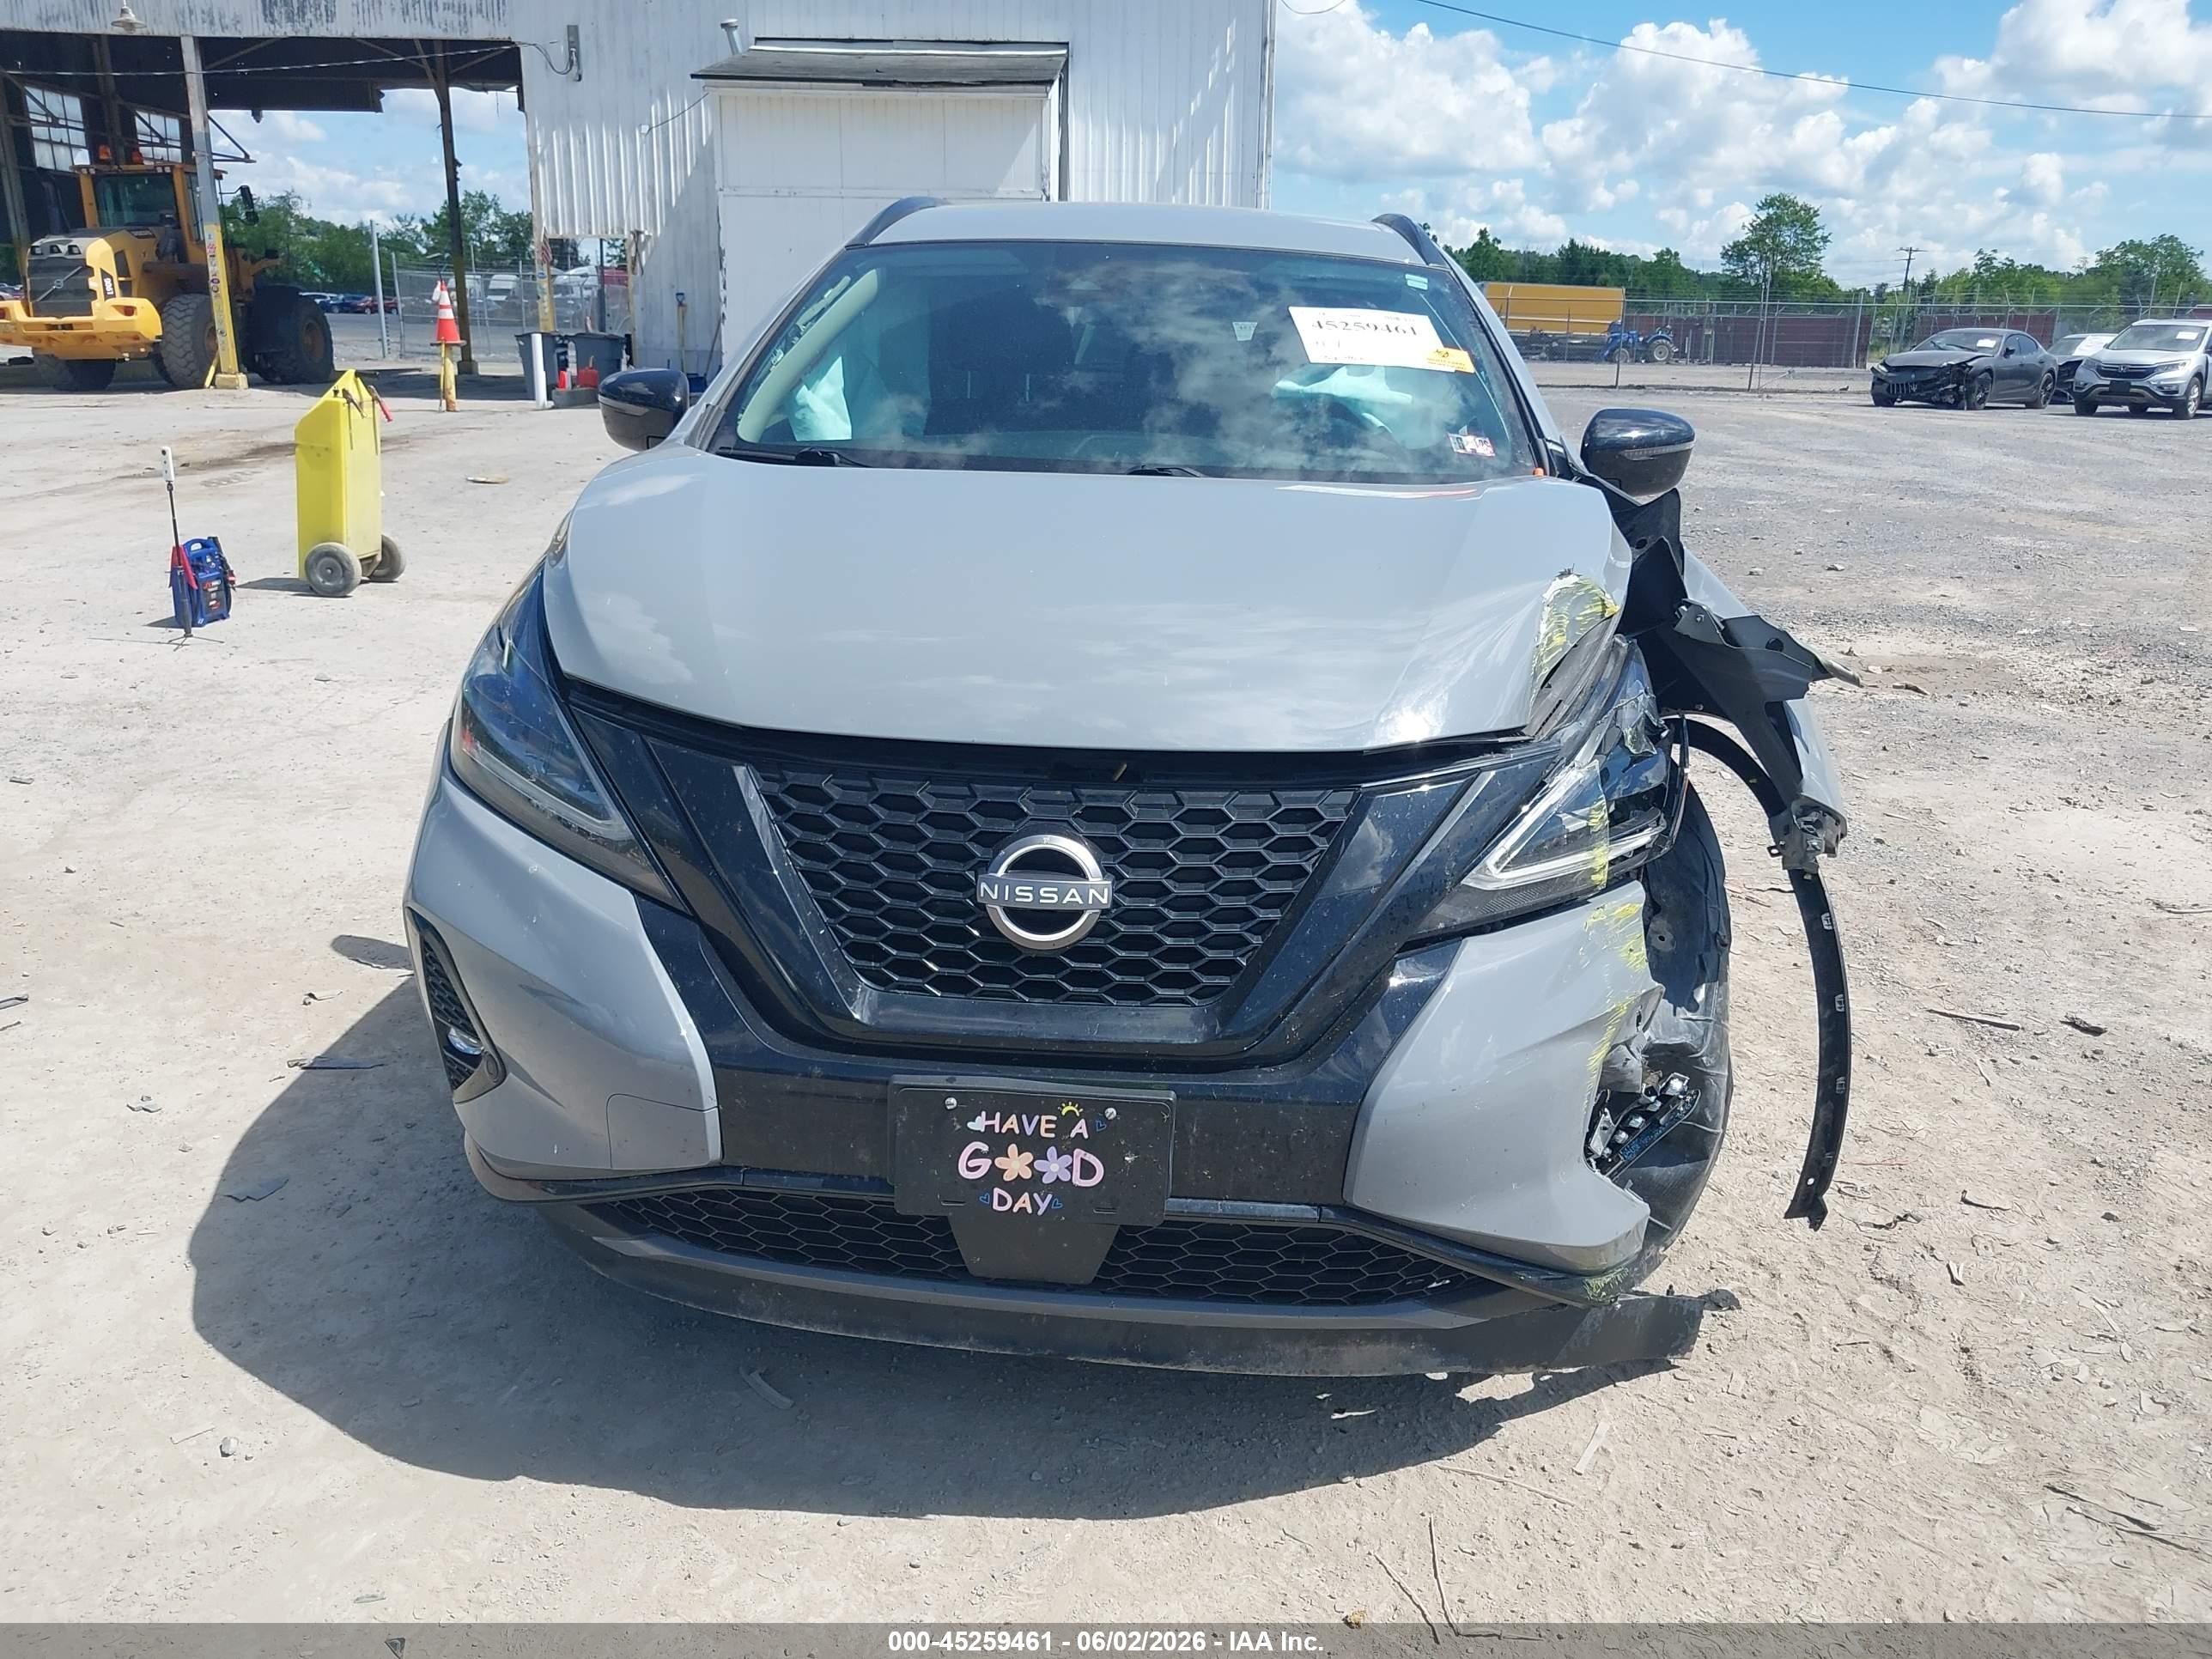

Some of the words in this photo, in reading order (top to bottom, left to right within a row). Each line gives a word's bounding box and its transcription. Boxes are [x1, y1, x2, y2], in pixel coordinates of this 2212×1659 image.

[1311, 319, 1419, 336] 45259461
[979, 881, 1109, 905] NISSAN
[981, 1110, 1058, 1139] HAVE
[1069, 1118, 1090, 1139] A
[992, 1187, 1054, 1216] DAY
